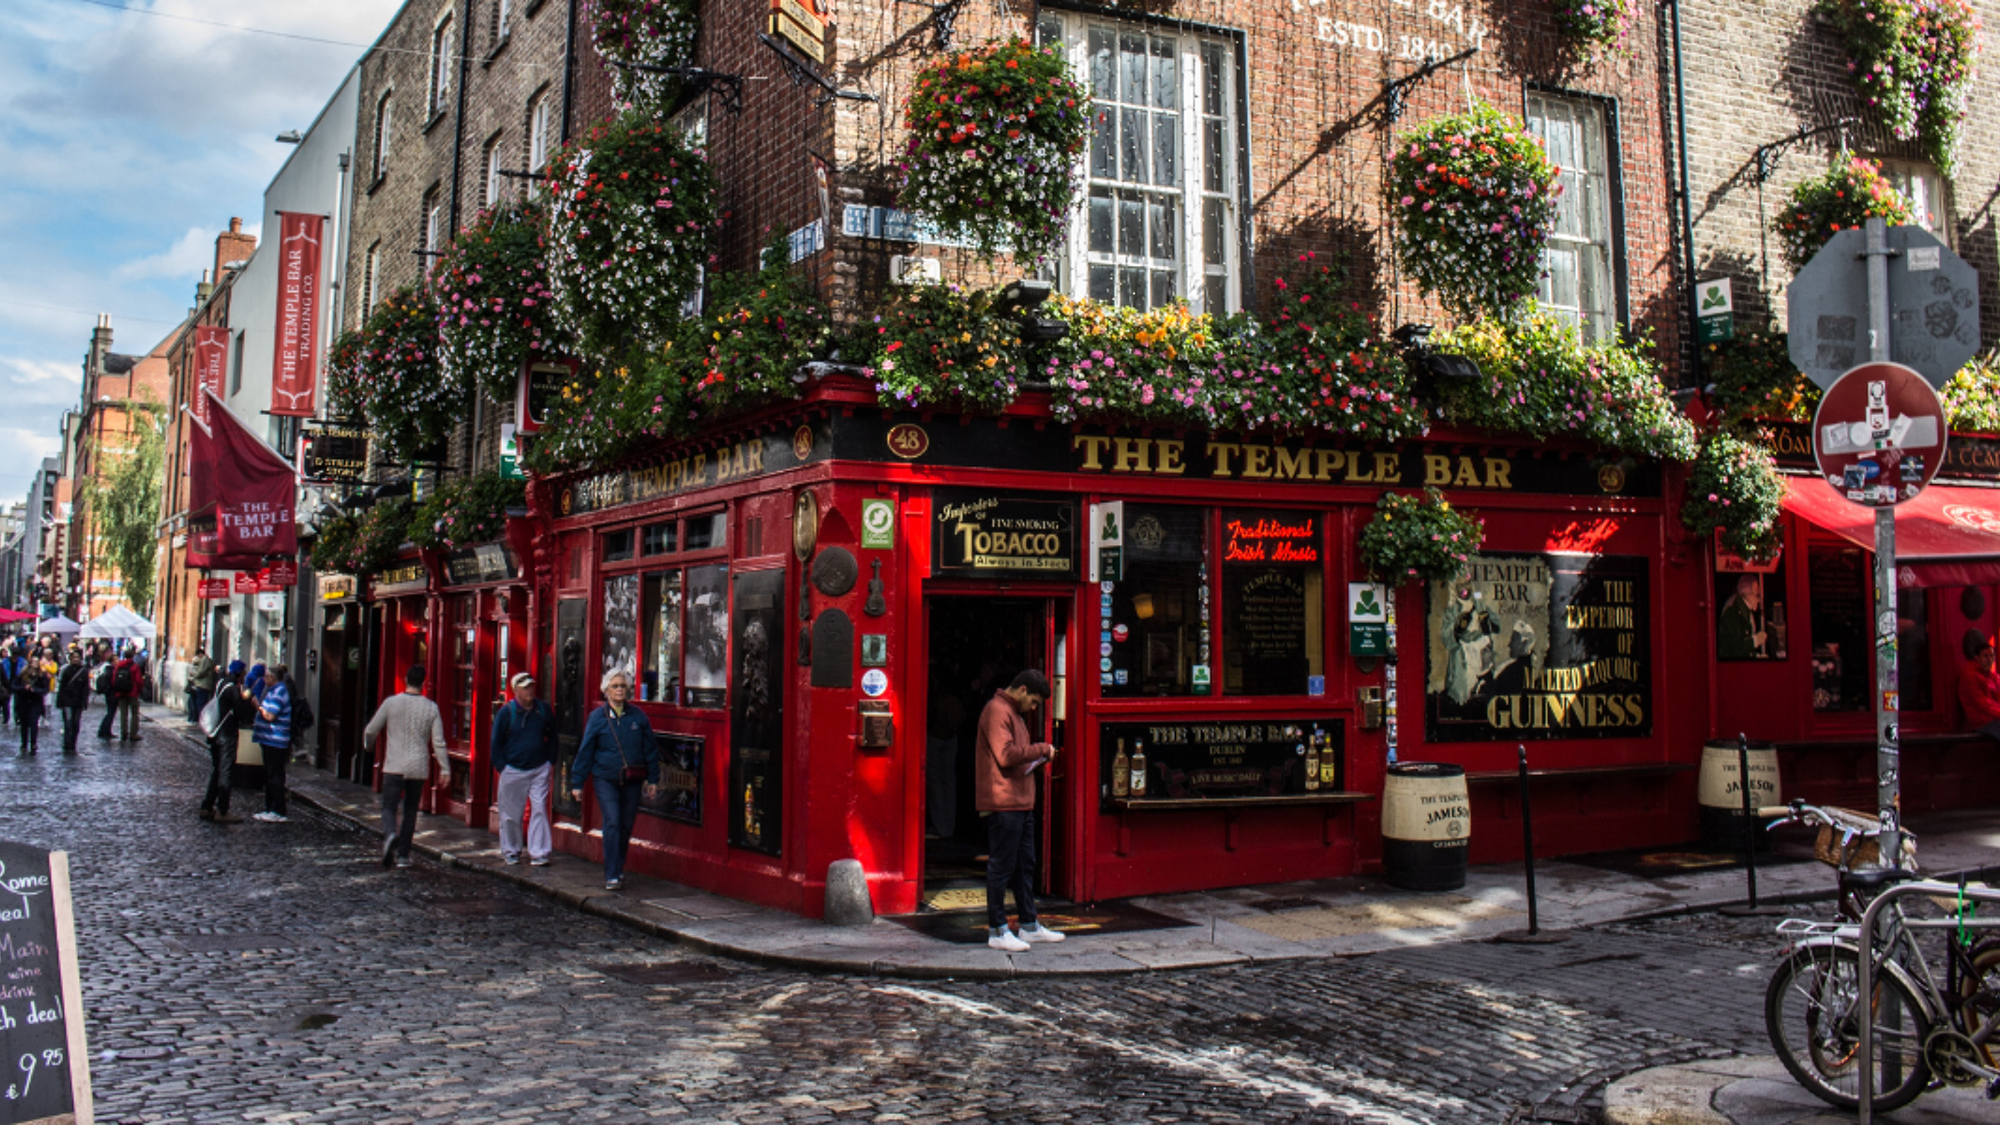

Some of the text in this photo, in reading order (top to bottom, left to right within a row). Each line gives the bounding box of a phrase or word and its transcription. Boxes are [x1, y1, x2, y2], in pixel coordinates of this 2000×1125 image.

[282, 249, 302, 383] THE TEMPLE BAR
[300, 273, 314, 361] TRADING CO.
[209, 351, 222, 377] THE
[895, 430, 920, 451] 48
[629, 454, 708, 500] TEMPLE
[716, 438, 766, 481] BAR
[1073, 434, 1513, 489] THE TEMPLE BAR
[221, 508, 290, 527] TEMPLE
[241, 501, 270, 512] THE
[937, 496, 1000, 523] Importers
[239, 525, 275, 539] BAR
[991, 517, 1060, 531] FINE SMOKING
[1227, 518, 1314, 540] Traditional
[954, 522, 1061, 563] TOBACCO
[1225, 539, 1318, 562] Irish Music
[976, 556, 1016, 568] Always
[1036, 557, 1070, 570] Stock
[1470, 563, 1547, 583] TEMPLE
[1493, 583, 1531, 603] BAR
[1603, 580, 1635, 603] THE
[1565, 604, 1635, 630] EMPEROR
[1617, 632, 1635, 655] OF
[1522, 659, 1641, 692] MALTED LIQUORS
[1486, 692, 1645, 730] GUINNESS
[1150, 725, 1188, 744] THE
[1191, 725, 1264, 744] TEMPLE
[1208, 744, 1247, 756] DUBLIN
[1191, 771, 1263, 785] LIVE MUSIC DAILY
[1721, 764, 1737, 772] THE
[1725, 779, 1776, 795] JAESON
[1420, 795, 1437, 805] THE
[0, 895, 30, 920] eal
[0, 932, 49, 962] Main
[8, 967, 42, 980] wine
[0, 984, 36, 999] drink
[26, 994, 63, 1024] deal
